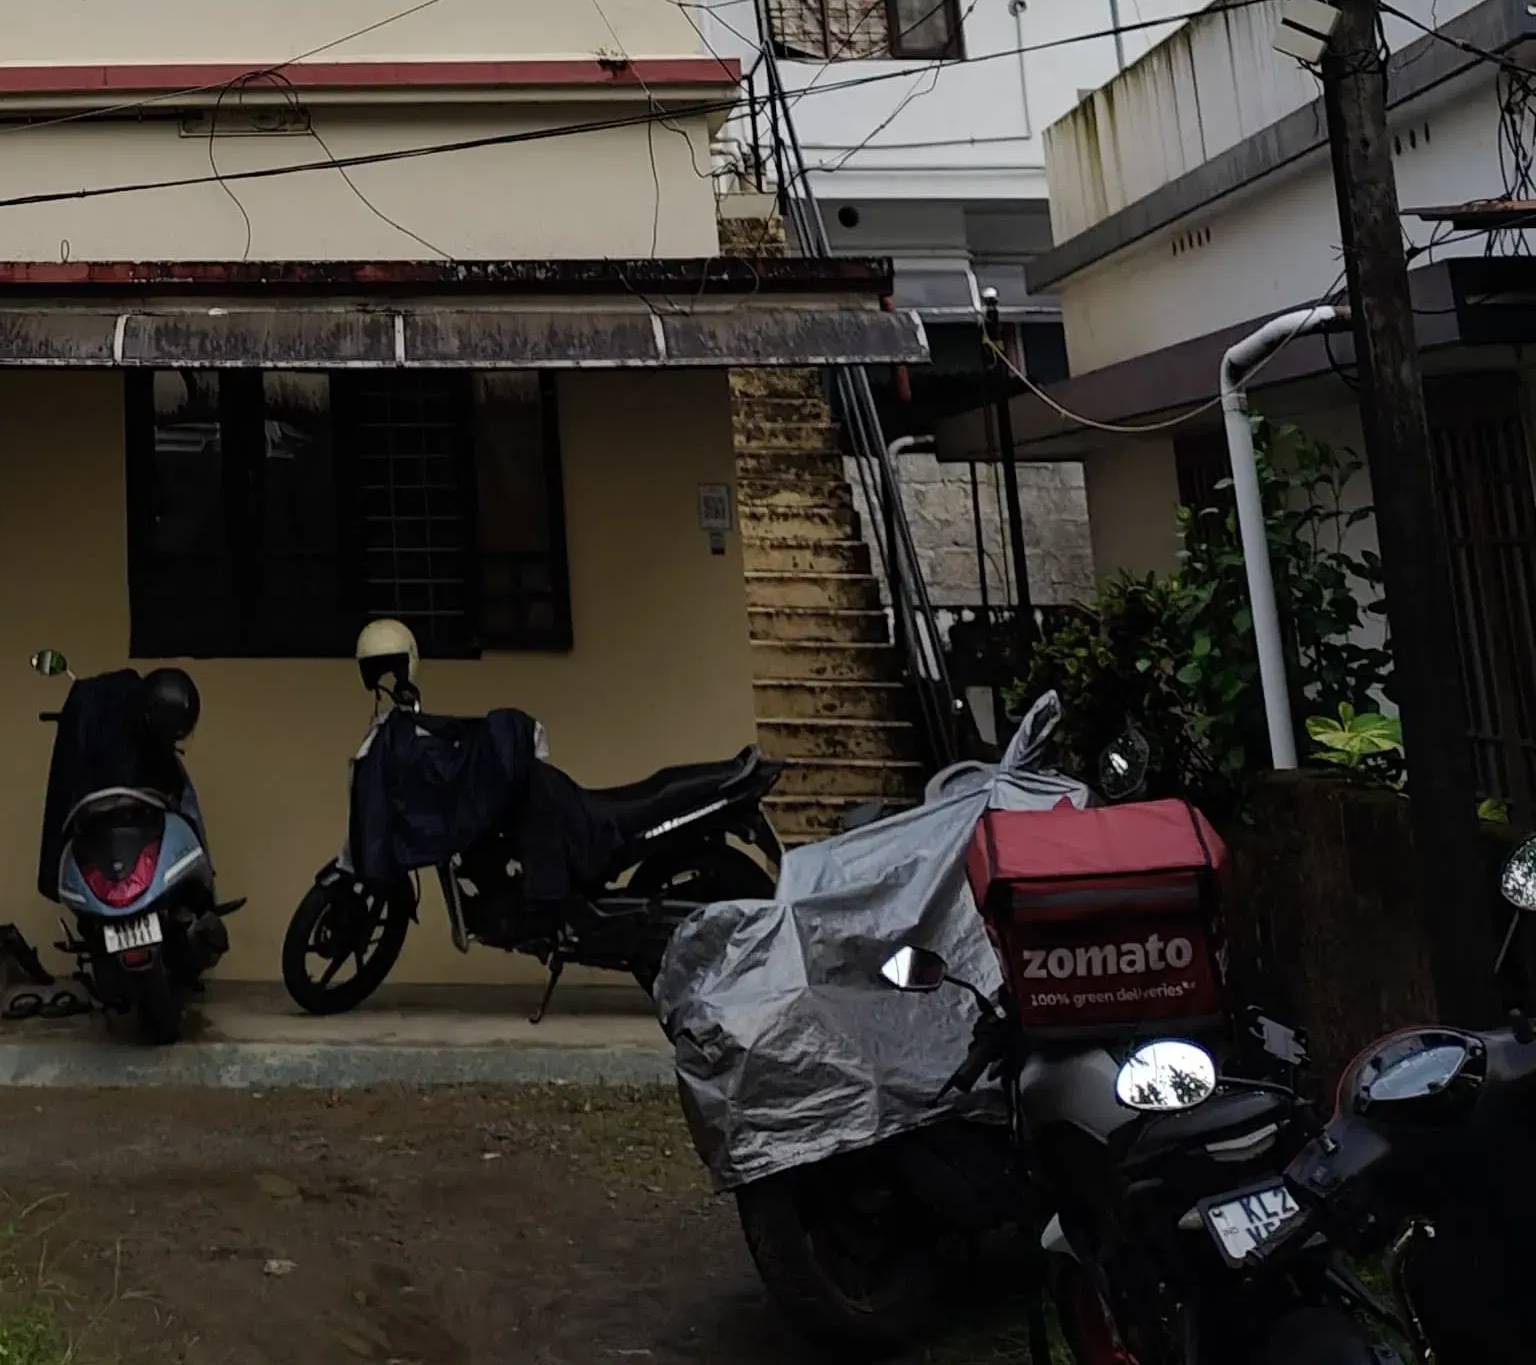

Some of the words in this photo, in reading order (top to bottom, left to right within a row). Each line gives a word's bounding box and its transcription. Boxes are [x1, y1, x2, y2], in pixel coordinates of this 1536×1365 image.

[1022, 933, 1194, 980] zomato
[1030, 992, 1070, 1008] 100%
[1073, 990, 1114, 1009] green
